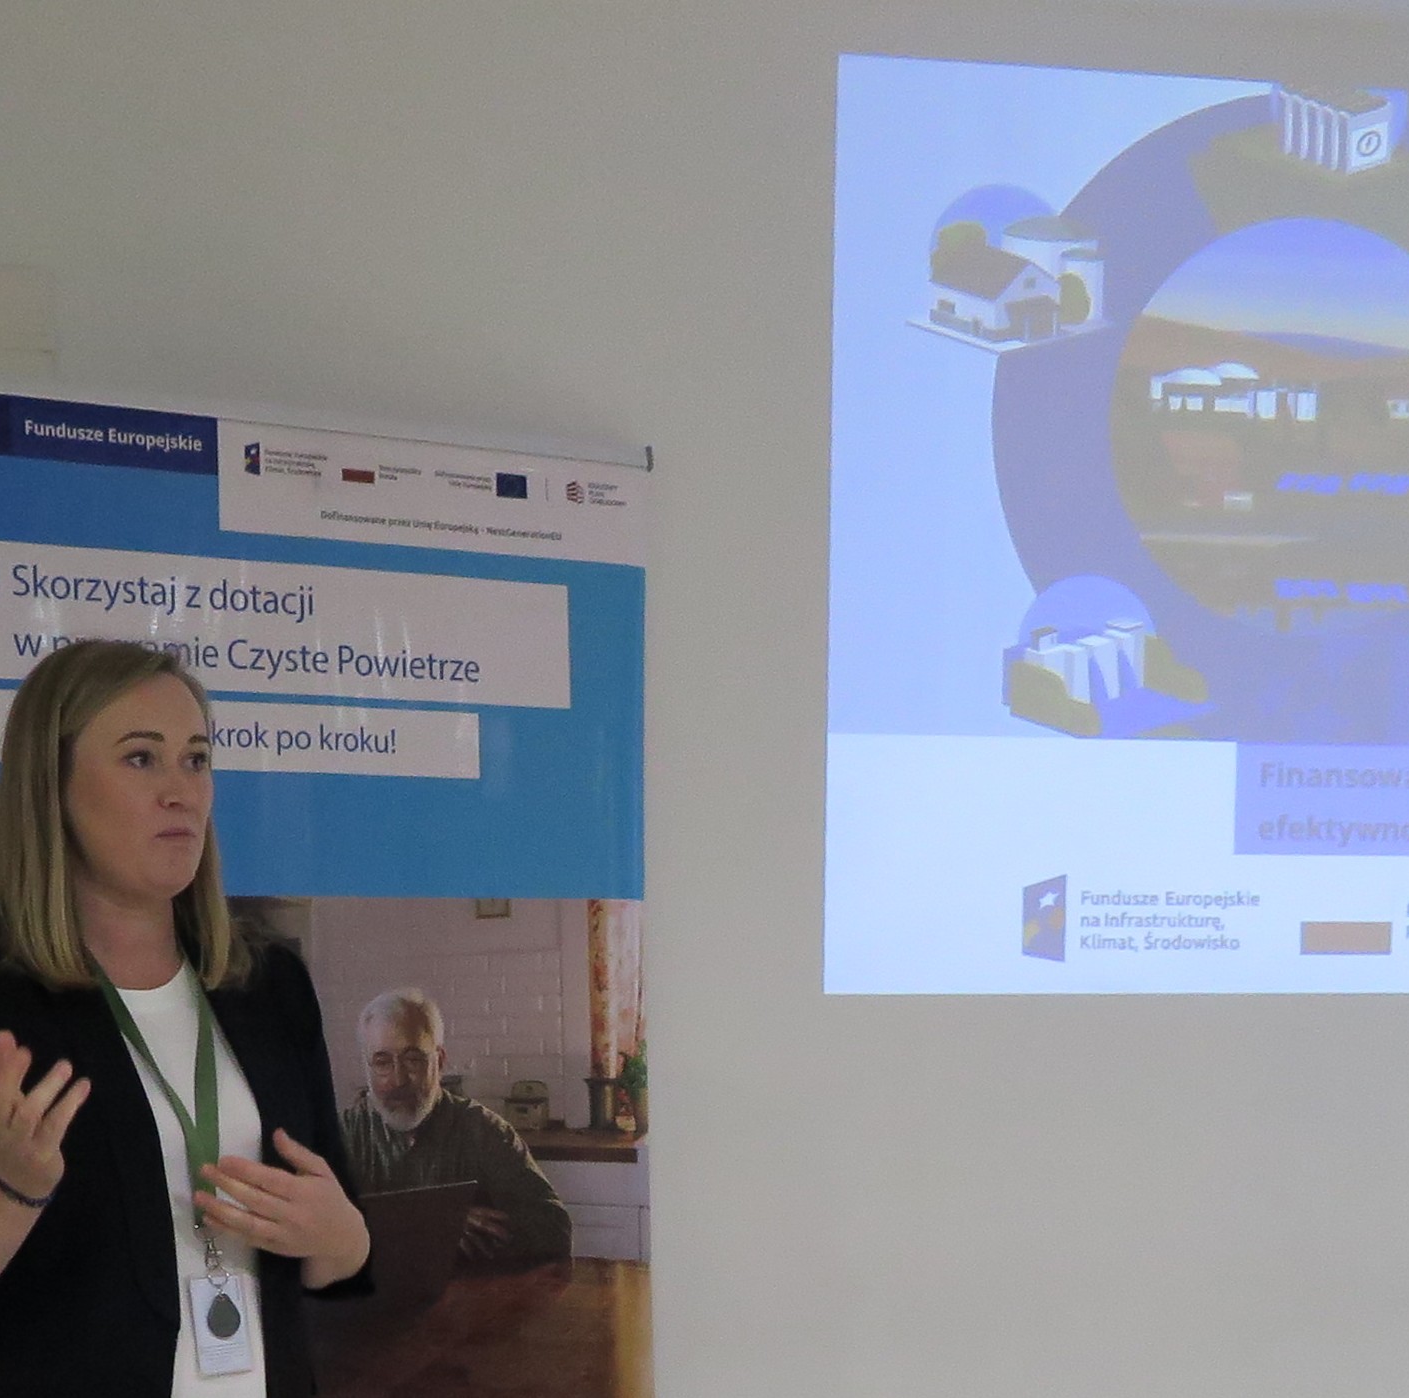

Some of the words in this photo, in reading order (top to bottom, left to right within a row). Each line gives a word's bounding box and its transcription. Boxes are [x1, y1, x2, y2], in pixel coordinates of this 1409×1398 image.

[24, 419, 104, 442] Fundusze
[108, 428, 203, 452] Europejskie
[12, 564, 177, 616] Skorzystaj
[186, 588, 202, 609] z
[209, 579, 315, 623] dotacji
[14, 633, 42, 657] w
[228, 638, 329, 679] Czyste
[338, 645, 481, 683] Powietrze
[212, 720, 269, 749] krok
[277, 728, 312, 755] po
[319, 724, 396, 754] kroku!
[1080, 890, 1159, 907] Fundusze
[1165, 891, 1261, 911] Europejskie
[1080, 914, 1101, 929] na
[1104, 911, 1225, 932] Infrastrukturę,
[1080, 934, 1138, 952] Klimat,
[1144, 931, 1240, 951] Środowisko
